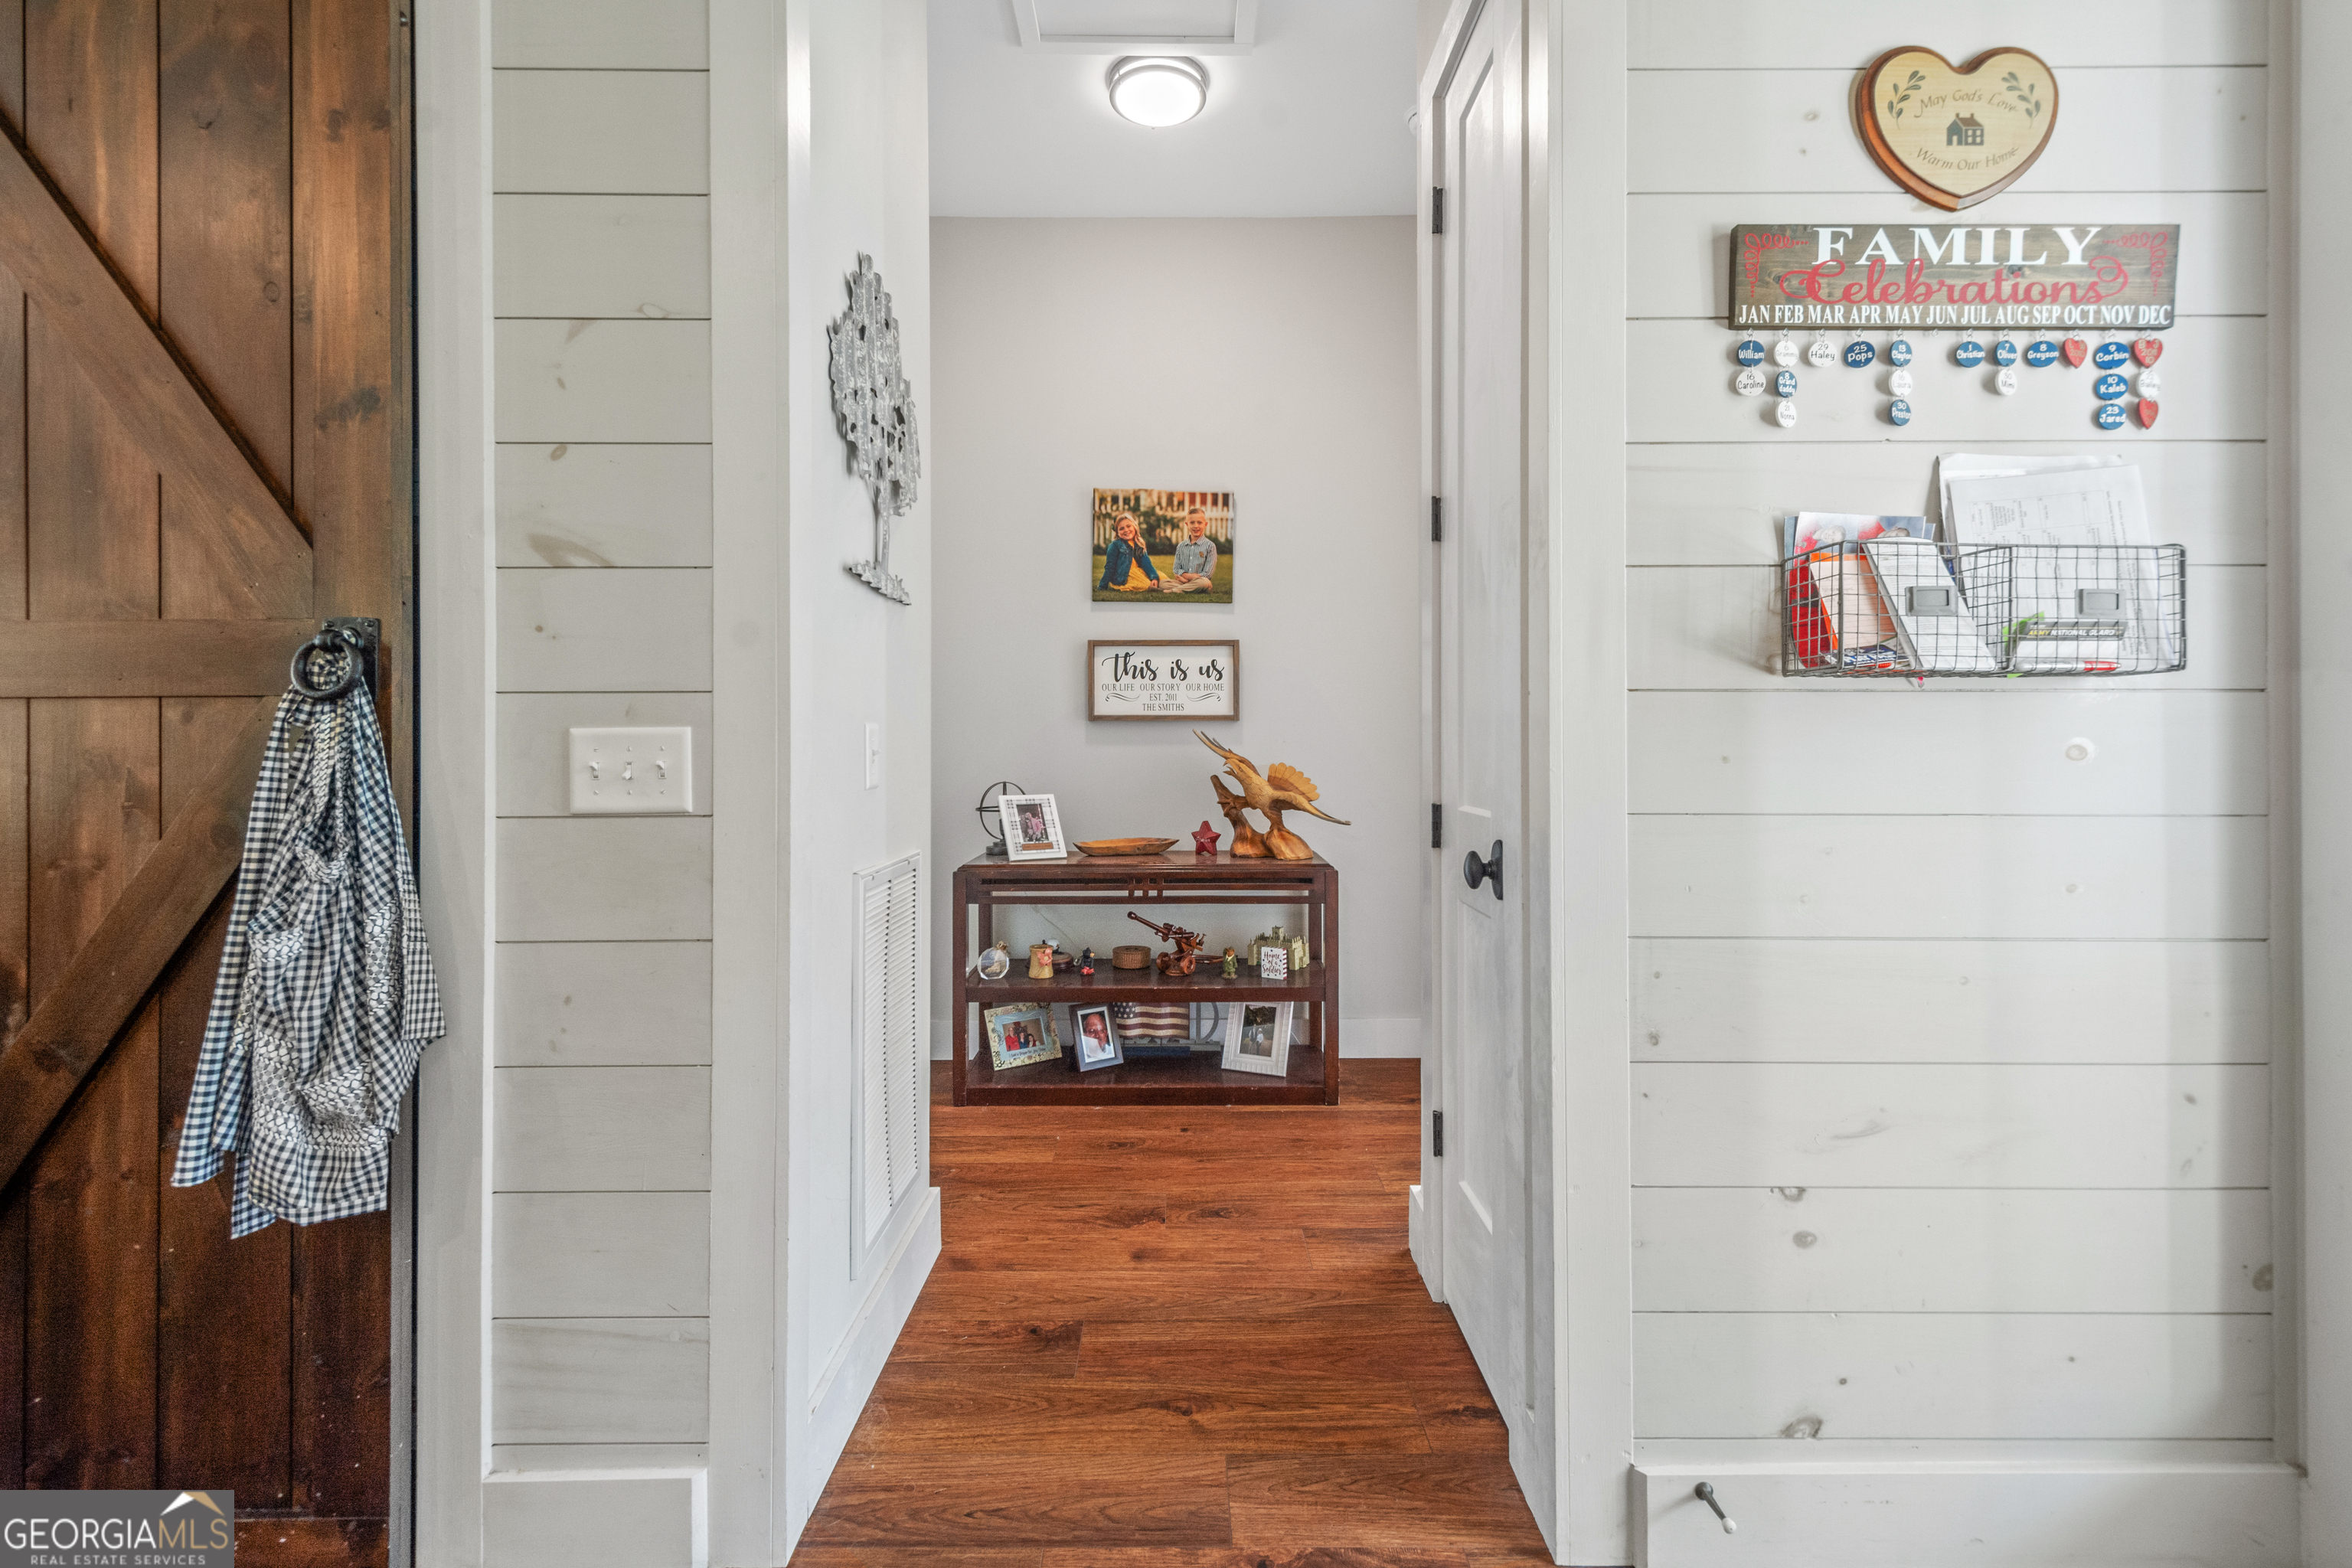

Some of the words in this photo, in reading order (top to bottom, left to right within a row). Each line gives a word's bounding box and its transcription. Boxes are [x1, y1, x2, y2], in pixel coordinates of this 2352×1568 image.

[1914, 94, 1947, 118] May
[1952, 89, 1983, 102] God's
[1988, 93, 2018, 113] Love
[1916, 148, 1953, 169] Warm
[1957, 158, 1981, 170] Our
[1985, 146, 2019, 168] Home
[1811, 227, 2102, 265] FAMILY
[1779, 255, 2128, 304] Celebrations
[1739, 305, 1771, 324] JAN
[1774, 305, 1804, 324] FEB
[1808, 305, 1844, 324] MAR
[1849, 305, 1881, 324] APR
[1885, 305, 1923, 324] MAY
[1926, 305, 1957, 324] JUN
[1961, 305, 1991, 325] JUL
[1994, 305, 2029, 325] AUG
[2032, 305, 2061, 325] SEP
[2063, 305, 2098, 325] OCT
[2100, 305, 2135, 325] NOV
[2138, 305, 2171, 325] DEC
[1854, 344, 1867, 354] 25
[2004, 343, 2011, 351] 7
[2040, 343, 2047, 352] 8
[2109, 344, 2116, 352] 9
[1738, 349, 1765, 359] William
[1811, 350, 1835, 361] Haley
[1956, 349, 1985, 359] Christian
[1997, 349, 2017, 360] Oliver
[2027, 351, 2060, 361] Greyson
[2096, 351, 2129, 362] Corbin
[1737, 378, 1765, 390] Caroline
[1779, 375, 1795, 386] Grand
[1779, 384, 1795, 395] daddy
[2099, 383, 2127, 394] Kaleb
[2106, 406, 2119, 414] 23
[2099, 413, 2127, 423] Jared
[1102, 652, 1158, 682] this
[1171, 658, 1189, 681] is
[1199, 658, 1225, 681] us
[1102, 683, 1117, 691] OUR
[1119, 683, 1135, 691] LIFE
[1139, 683, 1155, 691] OUR
[1157, 683, 1181, 691] STORY
[1185, 683, 1201, 691] OUR
[1203, 683, 1225, 691] HOME
[1149, 693, 1164, 701] EST.
[1165, 693, 1178, 701] 2011
[1142, 703, 1156, 711] THE
[1158, 703, 1184, 712] SMITHS
[1264, 951, 1280, 960] Home
[1263, 964, 1281, 975] Soldier
